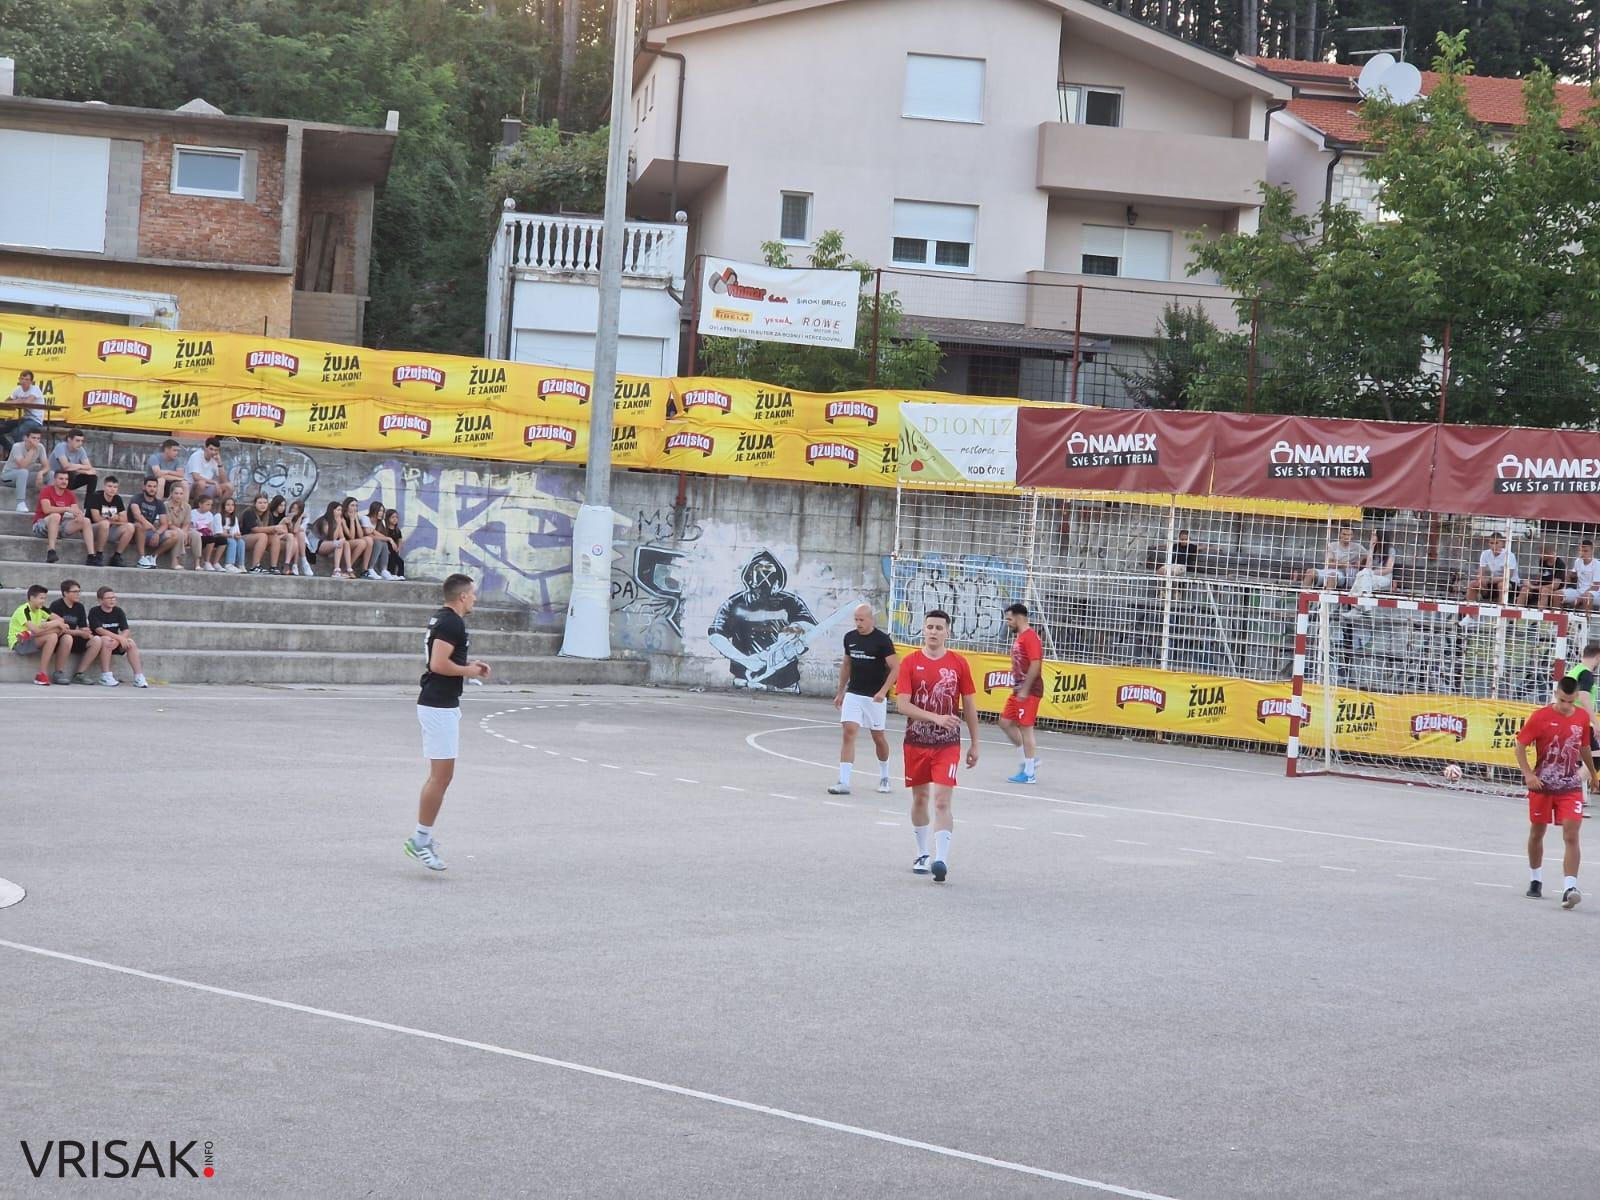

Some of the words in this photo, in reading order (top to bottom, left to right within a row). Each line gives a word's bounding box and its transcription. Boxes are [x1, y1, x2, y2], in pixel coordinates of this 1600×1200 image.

[802, 317, 840, 329] ROWE
[27, 326, 65, 346] ŽUJA
[24, 348, 33, 356] JE
[36, 346, 66, 356] ZAKON!
[102, 340, 148, 357] Ožujsko
[176, 339, 213, 358] ŽUJA
[174, 360, 182, 369] JE
[186, 358, 215, 368] ZAKON!
[250, 352, 295, 370] Ožujsko
[323, 352, 360, 372] ŽUJA
[321, 373, 330, 382] JE
[332, 371, 362, 382] ZAKON!
[397, 366, 442, 383] Ožujsko
[469, 365, 506, 385] ŽUJA
[467, 387, 476, 396] JE
[478, 384, 508, 394] ZAKON!
[542, 380, 586, 397] Ožujsko
[614, 380, 650, 399] ŽUJA
[87, 390, 132, 408] Ožujsko
[161, 390, 199, 410] ŽUJA
[622, 400, 652, 410] ZAKON!
[686, 390, 728, 407] Ožujsko
[756, 390, 792, 410] ŽUJA
[159, 411, 168, 420] JE
[170, 408, 200, 418] ZAKON!
[236, 404, 281, 420] Ožujsko
[309, 403, 346, 422] ŽUJA
[754, 411, 763, 420] JE
[765, 409, 794, 420] ZAKON!
[829, 402, 874, 418] Ožujsko
[307, 424, 316, 432] JE
[318, 421, 348, 432] ZAKON!
[383, 415, 428, 432] Ožujsko
[455, 412, 492, 433] ŽUJA
[924, 416, 1012, 436] DIONIZ
[453, 435, 462, 444] JE
[464, 432, 494, 442] ZAKON!
[528, 426, 572, 442] Ožujsko
[612, 425, 636, 442] UJA
[737, 432, 774, 452] ŽUJA
[1090, 433, 1157, 453] NAMEX
[734, 453, 744, 462] JE
[746, 450, 776, 461] ZAKON!
[810, 444, 854, 461] Ožujsko
[882, 443, 898, 463] ŽU
[1072, 456, 1089, 466] SVE
[1113, 455, 1122, 464] TI
[1126, 454, 1153, 464] TREBA
[1294, 444, 1370, 464] NAMEX
[880, 464, 890, 474] JE
[968, 466, 985, 475] KOD
[1275, 466, 1293, 477] SVE
[1321, 466, 1330, 476] TI
[1334, 466, 1366, 476] TREBA
[1502, 481, 1522, 492] SVE
[1554, 480, 1564, 491] TI
[988, 672, 1015, 688] Ožujs
[1054, 671, 1087, 692] ŽUJA
[1051, 694, 1060, 704] JE
[1062, 692, 1088, 703] ZAKON!
[1120, 685, 1162, 705] Ožujsko
[1188, 685, 1225, 706] ŽUJA
[1186, 709, 1196, 718] JE
[1198, 706, 1227, 717] ZAKON!
[1262, 700, 1308, 720] Ožujso
[1336, 698, 1376, 722] ŽUJA
[1336, 724, 1344, 734] JE
[1346, 722, 1378, 733] ZAKON!
[1415, 714, 1462, 734] Ožujsko
[1491, 738, 1502, 748] JE
[1574, 801, 1582, 814] 3
